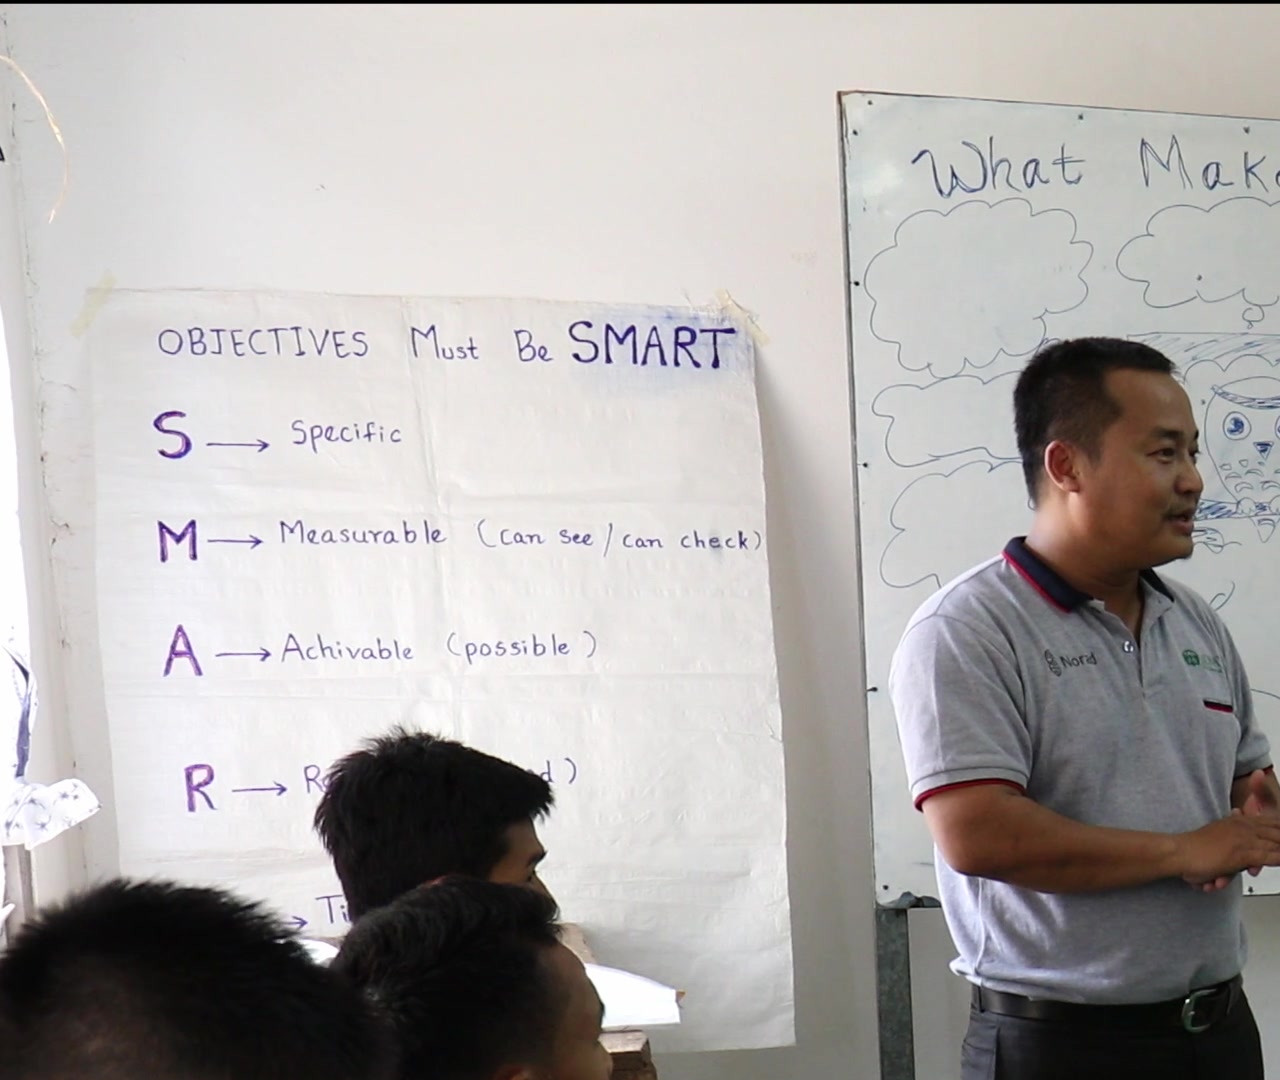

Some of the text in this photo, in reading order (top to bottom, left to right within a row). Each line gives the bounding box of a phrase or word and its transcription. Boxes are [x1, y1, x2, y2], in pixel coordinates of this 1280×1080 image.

[911, 135, 1086, 199] What
[156, 319, 738, 369] OBJECTIVES Must Be SMART
[153, 411, 193, 460] S
[291, 420, 404, 454] Specific
[157, 518, 199, 563] M
[279, 518, 448, 547] Measurable
[680, 528, 763, 553] check)
[163, 623, 204, 677] A
[280, 631, 415, 663] Achivable
[182, 763, 217, 813] R
